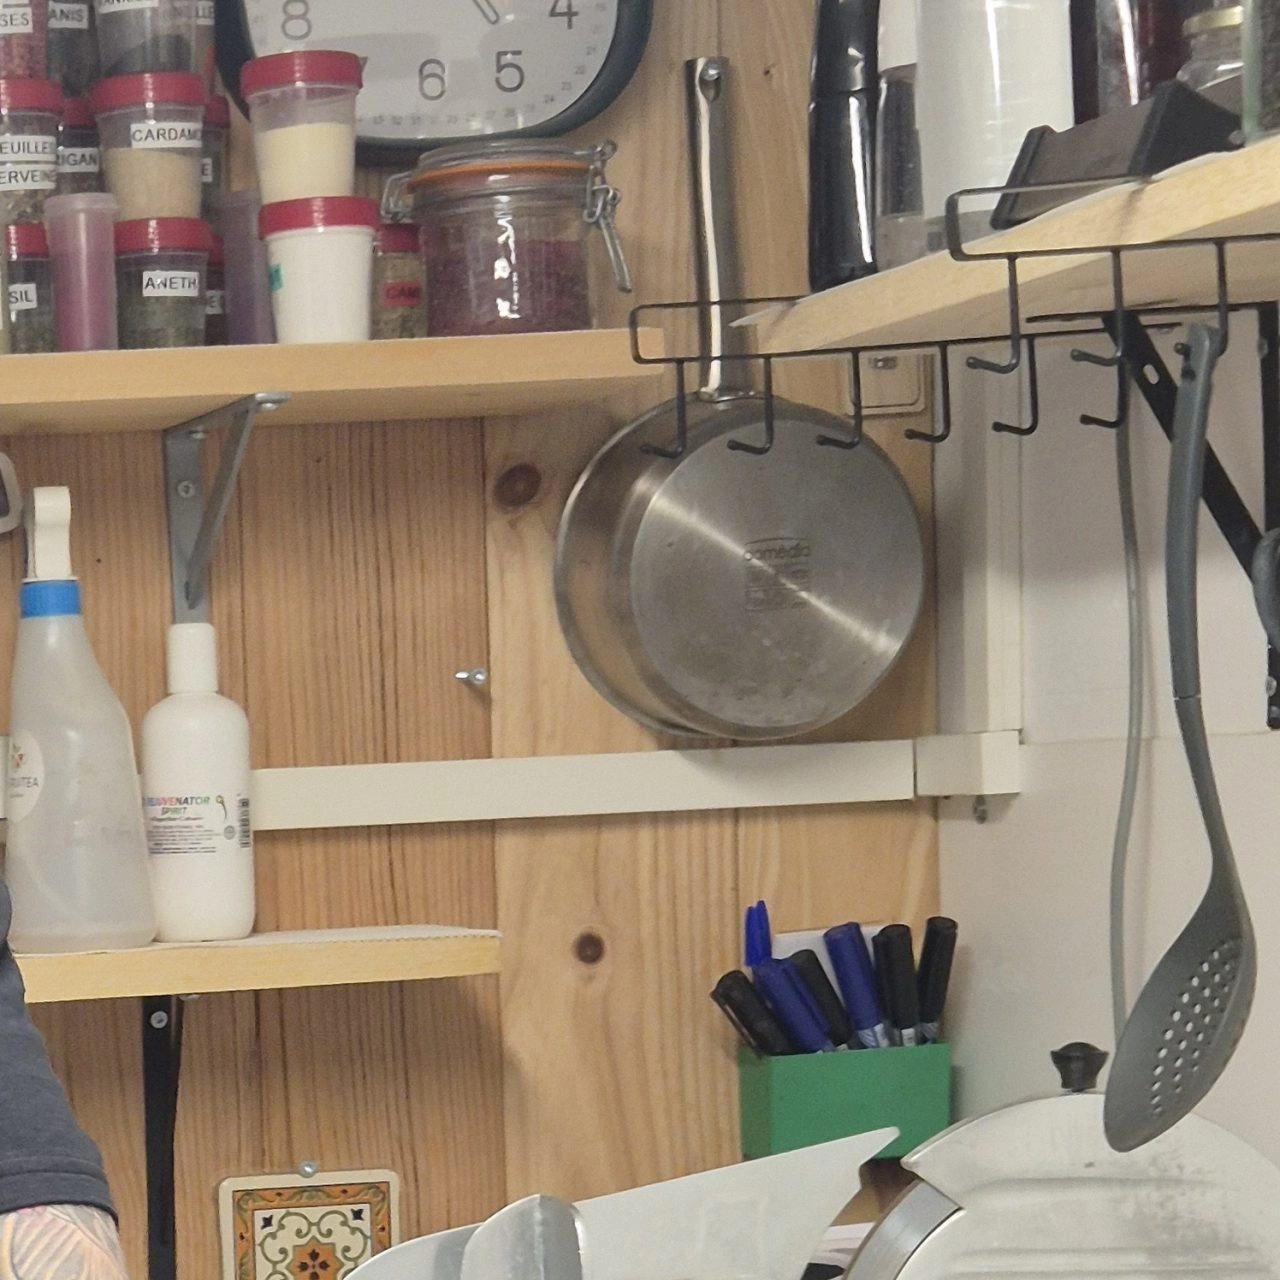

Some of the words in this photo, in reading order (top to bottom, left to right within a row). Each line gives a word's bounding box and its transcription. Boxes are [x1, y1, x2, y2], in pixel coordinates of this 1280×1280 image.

[281, 0, 312, 40] 8
[419, 58, 446, 101] 6
[495, 50, 524, 93] 5
